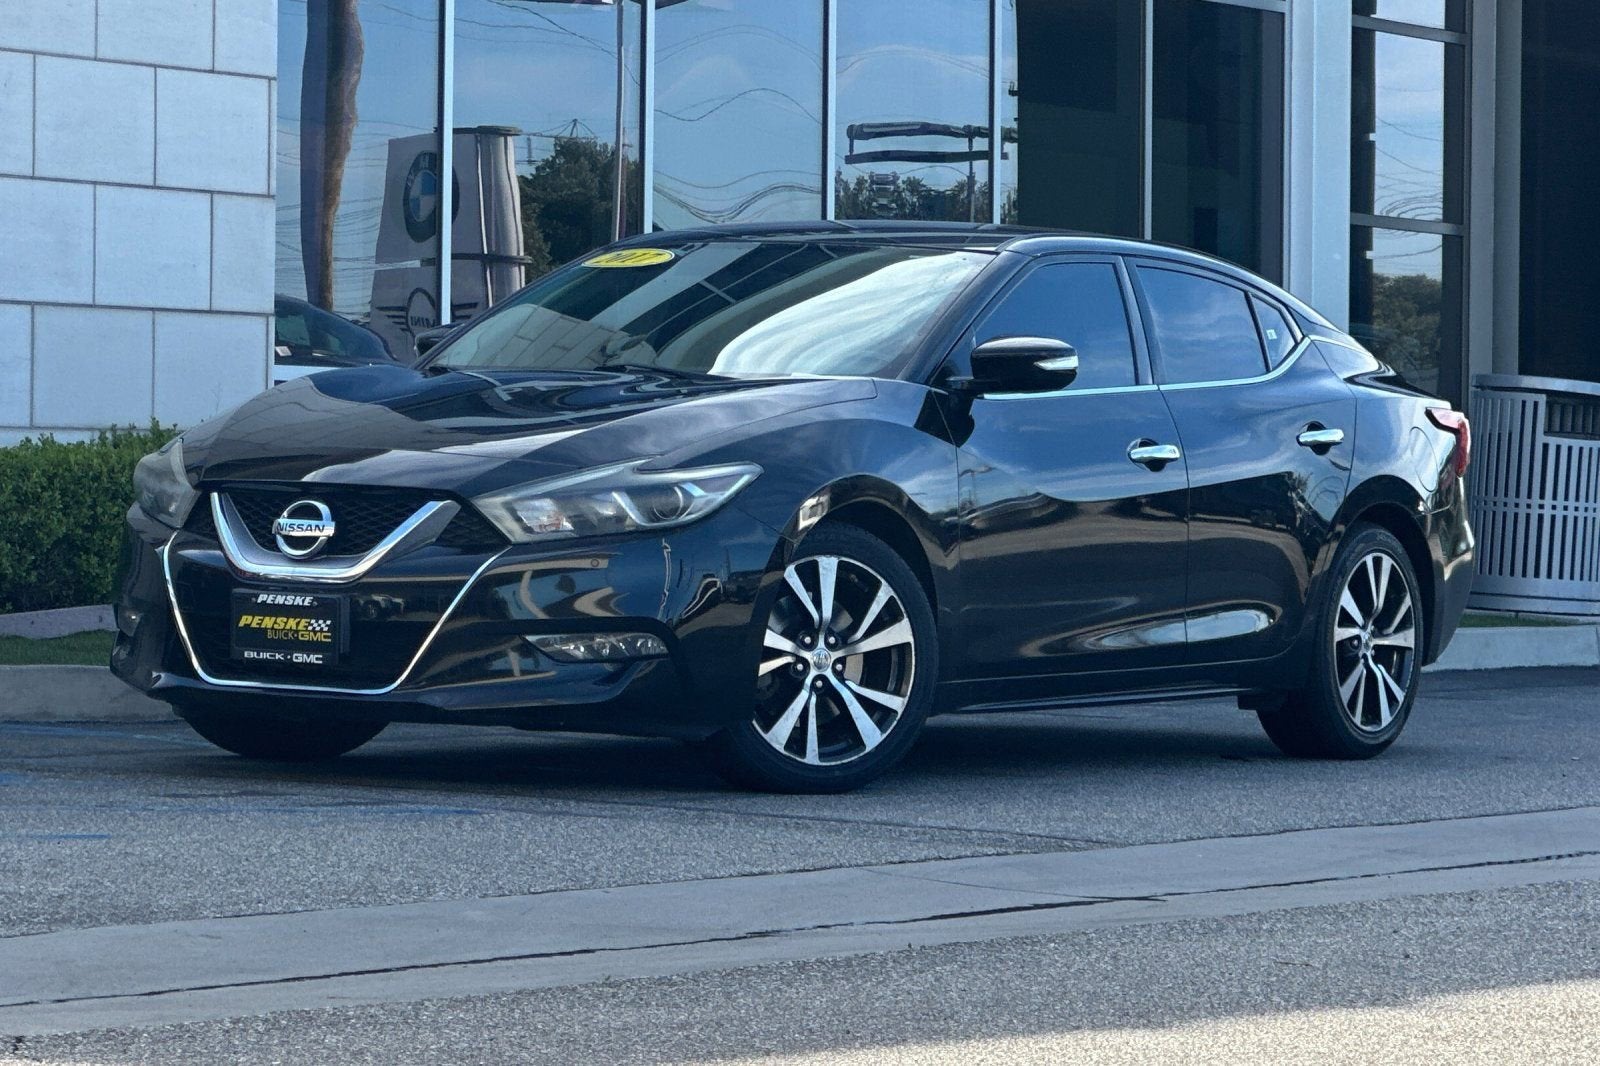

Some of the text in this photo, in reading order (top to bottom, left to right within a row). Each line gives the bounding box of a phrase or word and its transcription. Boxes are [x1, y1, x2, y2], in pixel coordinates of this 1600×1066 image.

[276, 522, 326, 533] NISSAN
[257, 594, 314, 606] PENSKE
[238, 615, 311, 631] PENSKE
[244, 650, 323, 664] BUICK GMC
